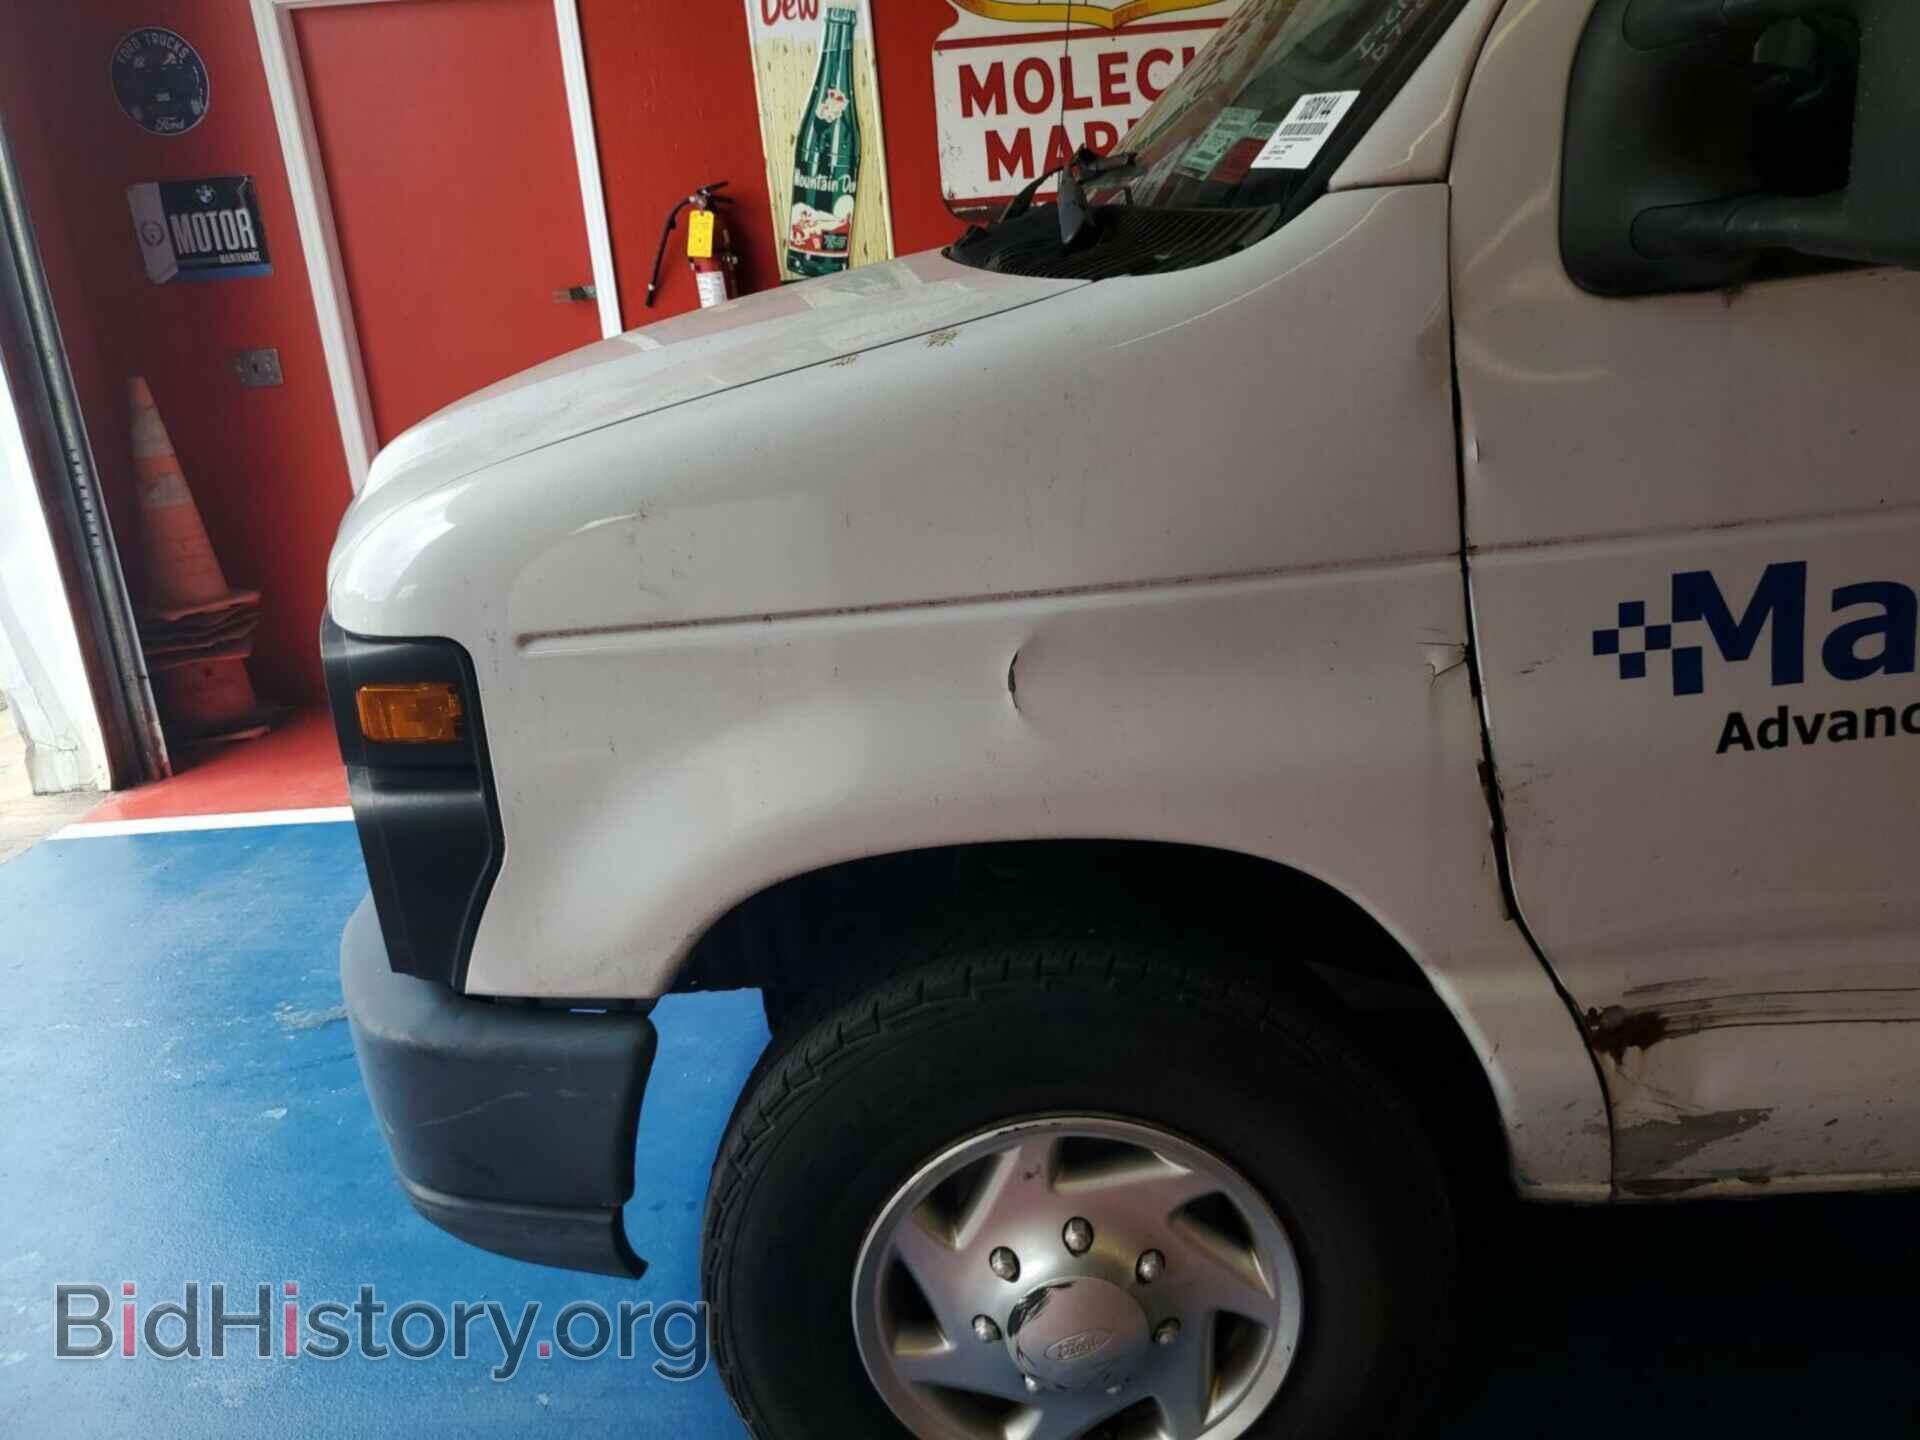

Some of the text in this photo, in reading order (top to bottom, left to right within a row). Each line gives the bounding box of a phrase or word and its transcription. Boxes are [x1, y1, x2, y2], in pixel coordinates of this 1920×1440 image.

[143, 31, 190, 59] TRUCKS
[984, 118, 1138, 182] MAR
[169, 207, 257, 256] MOTOR
[1671, 560, 1919, 696] Ma
